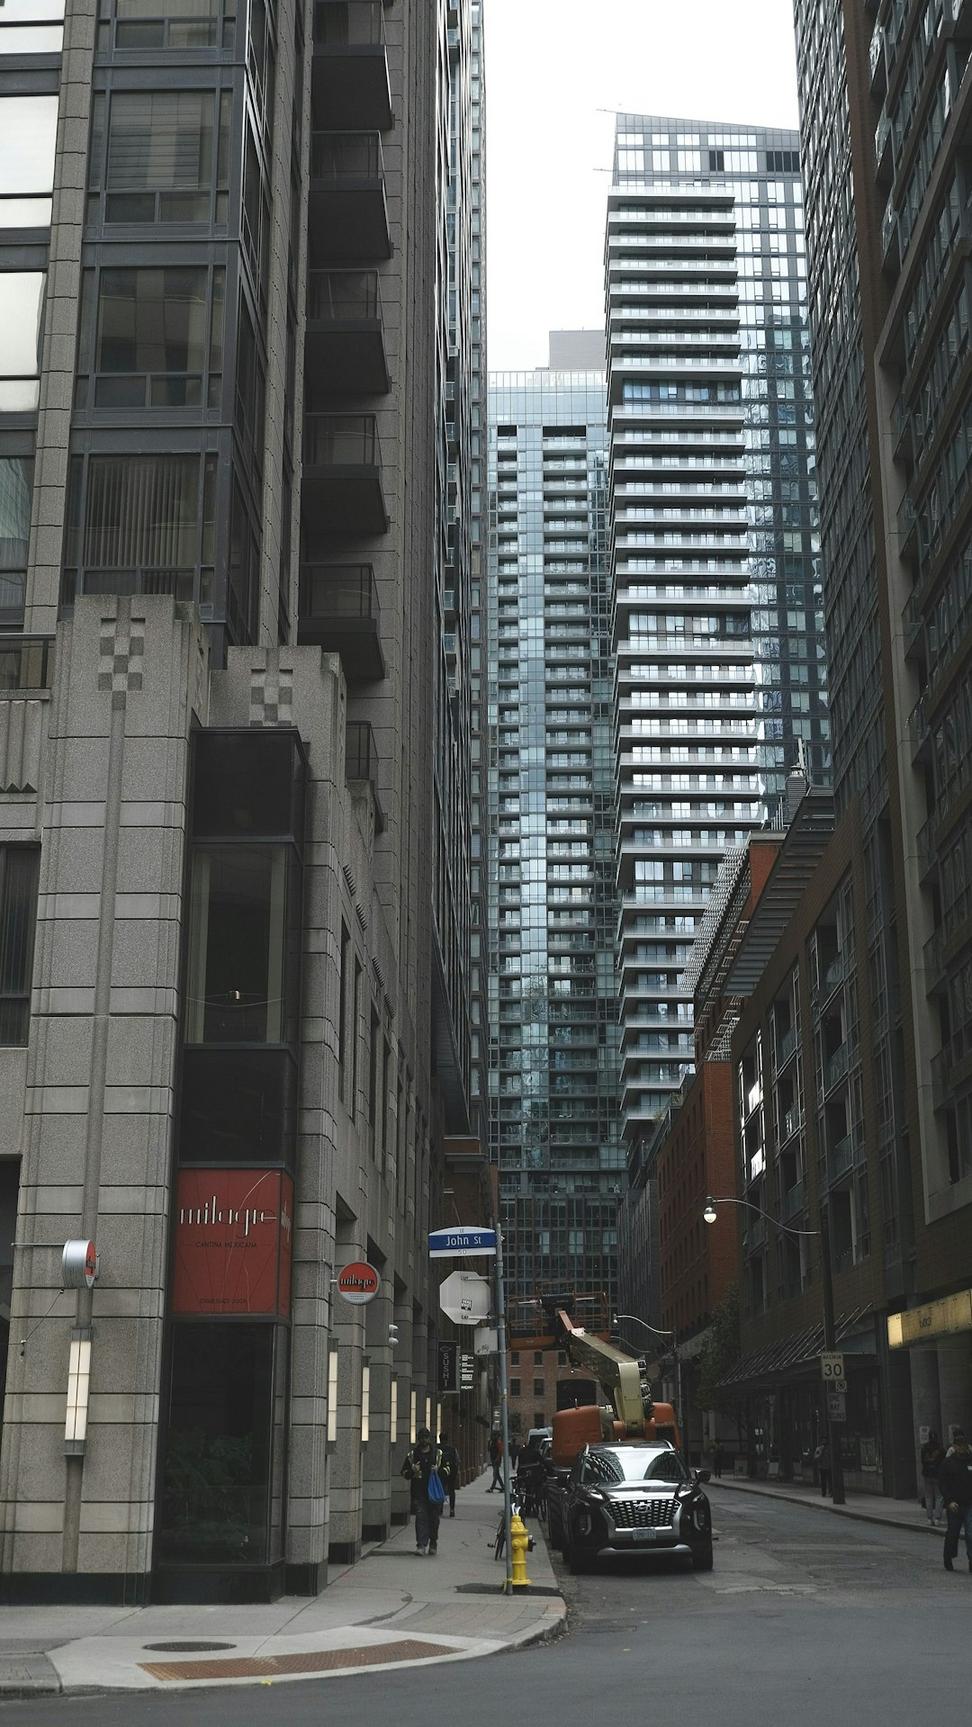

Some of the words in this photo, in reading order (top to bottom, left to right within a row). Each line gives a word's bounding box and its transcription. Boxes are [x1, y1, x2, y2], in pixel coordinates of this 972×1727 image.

[446, 1235, 469, 1247] John
[473, 1235, 482, 1245] St
[824, 1363, 842, 1377] 30
